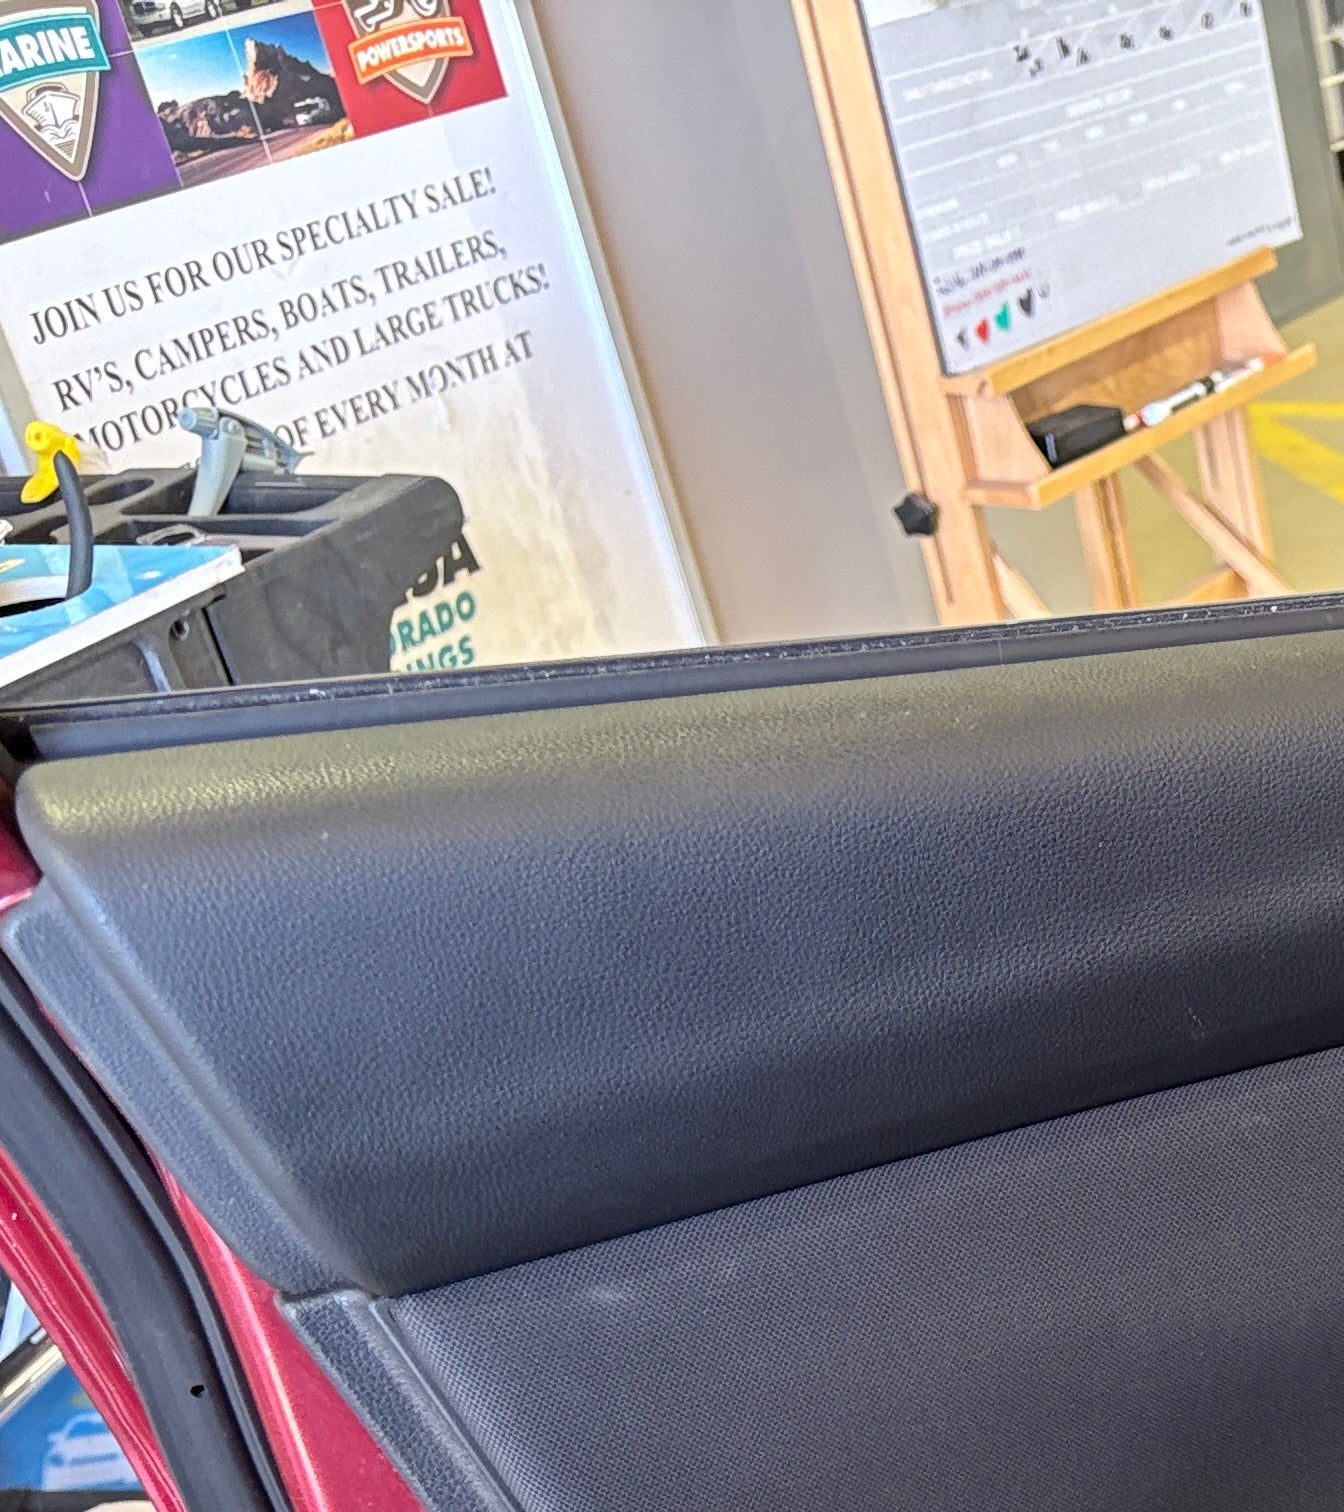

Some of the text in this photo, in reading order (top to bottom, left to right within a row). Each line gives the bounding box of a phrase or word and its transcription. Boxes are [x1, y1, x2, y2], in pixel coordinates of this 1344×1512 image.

[0, 26, 96, 78] ARINE
[357, 26, 465, 72] POWERSPORTS
[30, 167, 496, 345] JOIN US FOR OUR SPECIALTY SALE!
[52, 230, 508, 412] RV'S, CAMPERS, BOATS, TRAILERS,
[299, 335, 351, 380] AND
[353, 301, 444, 357] LARGE
[442, 263, 549, 322] TRUCKS!
[273, 330, 534, 448] OF EVERY MONTH AT
